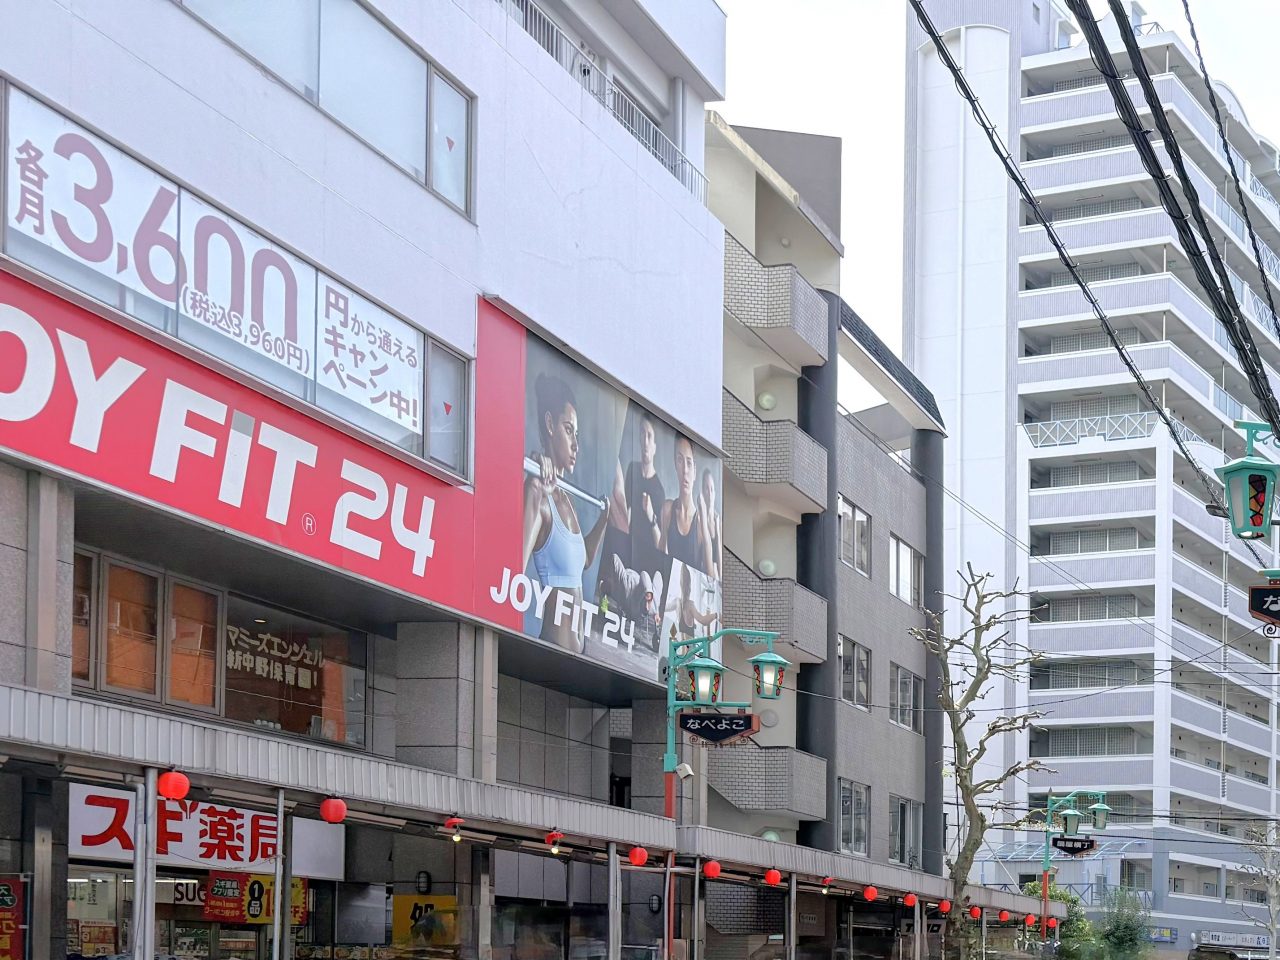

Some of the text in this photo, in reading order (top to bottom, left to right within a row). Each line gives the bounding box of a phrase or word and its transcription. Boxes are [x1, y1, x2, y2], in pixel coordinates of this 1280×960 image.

[14, 138, 49, 236] 各月
[181, 284, 311, 376] (税込3,960円)
[324, 285, 419, 369] 円から通える
[324, 325, 390, 378] キャン
[322, 362, 419, 428] ペーン中!
[149, 378, 317, 526] FIT
[329, 459, 436, 578] 24
[226, 624, 325, 668] マミーズエンジェル
[489, 567, 636, 653] JOY FIT 24
[686, 718, 745, 731] なべよこ
[81, 793, 280, 862] スギ薬局
